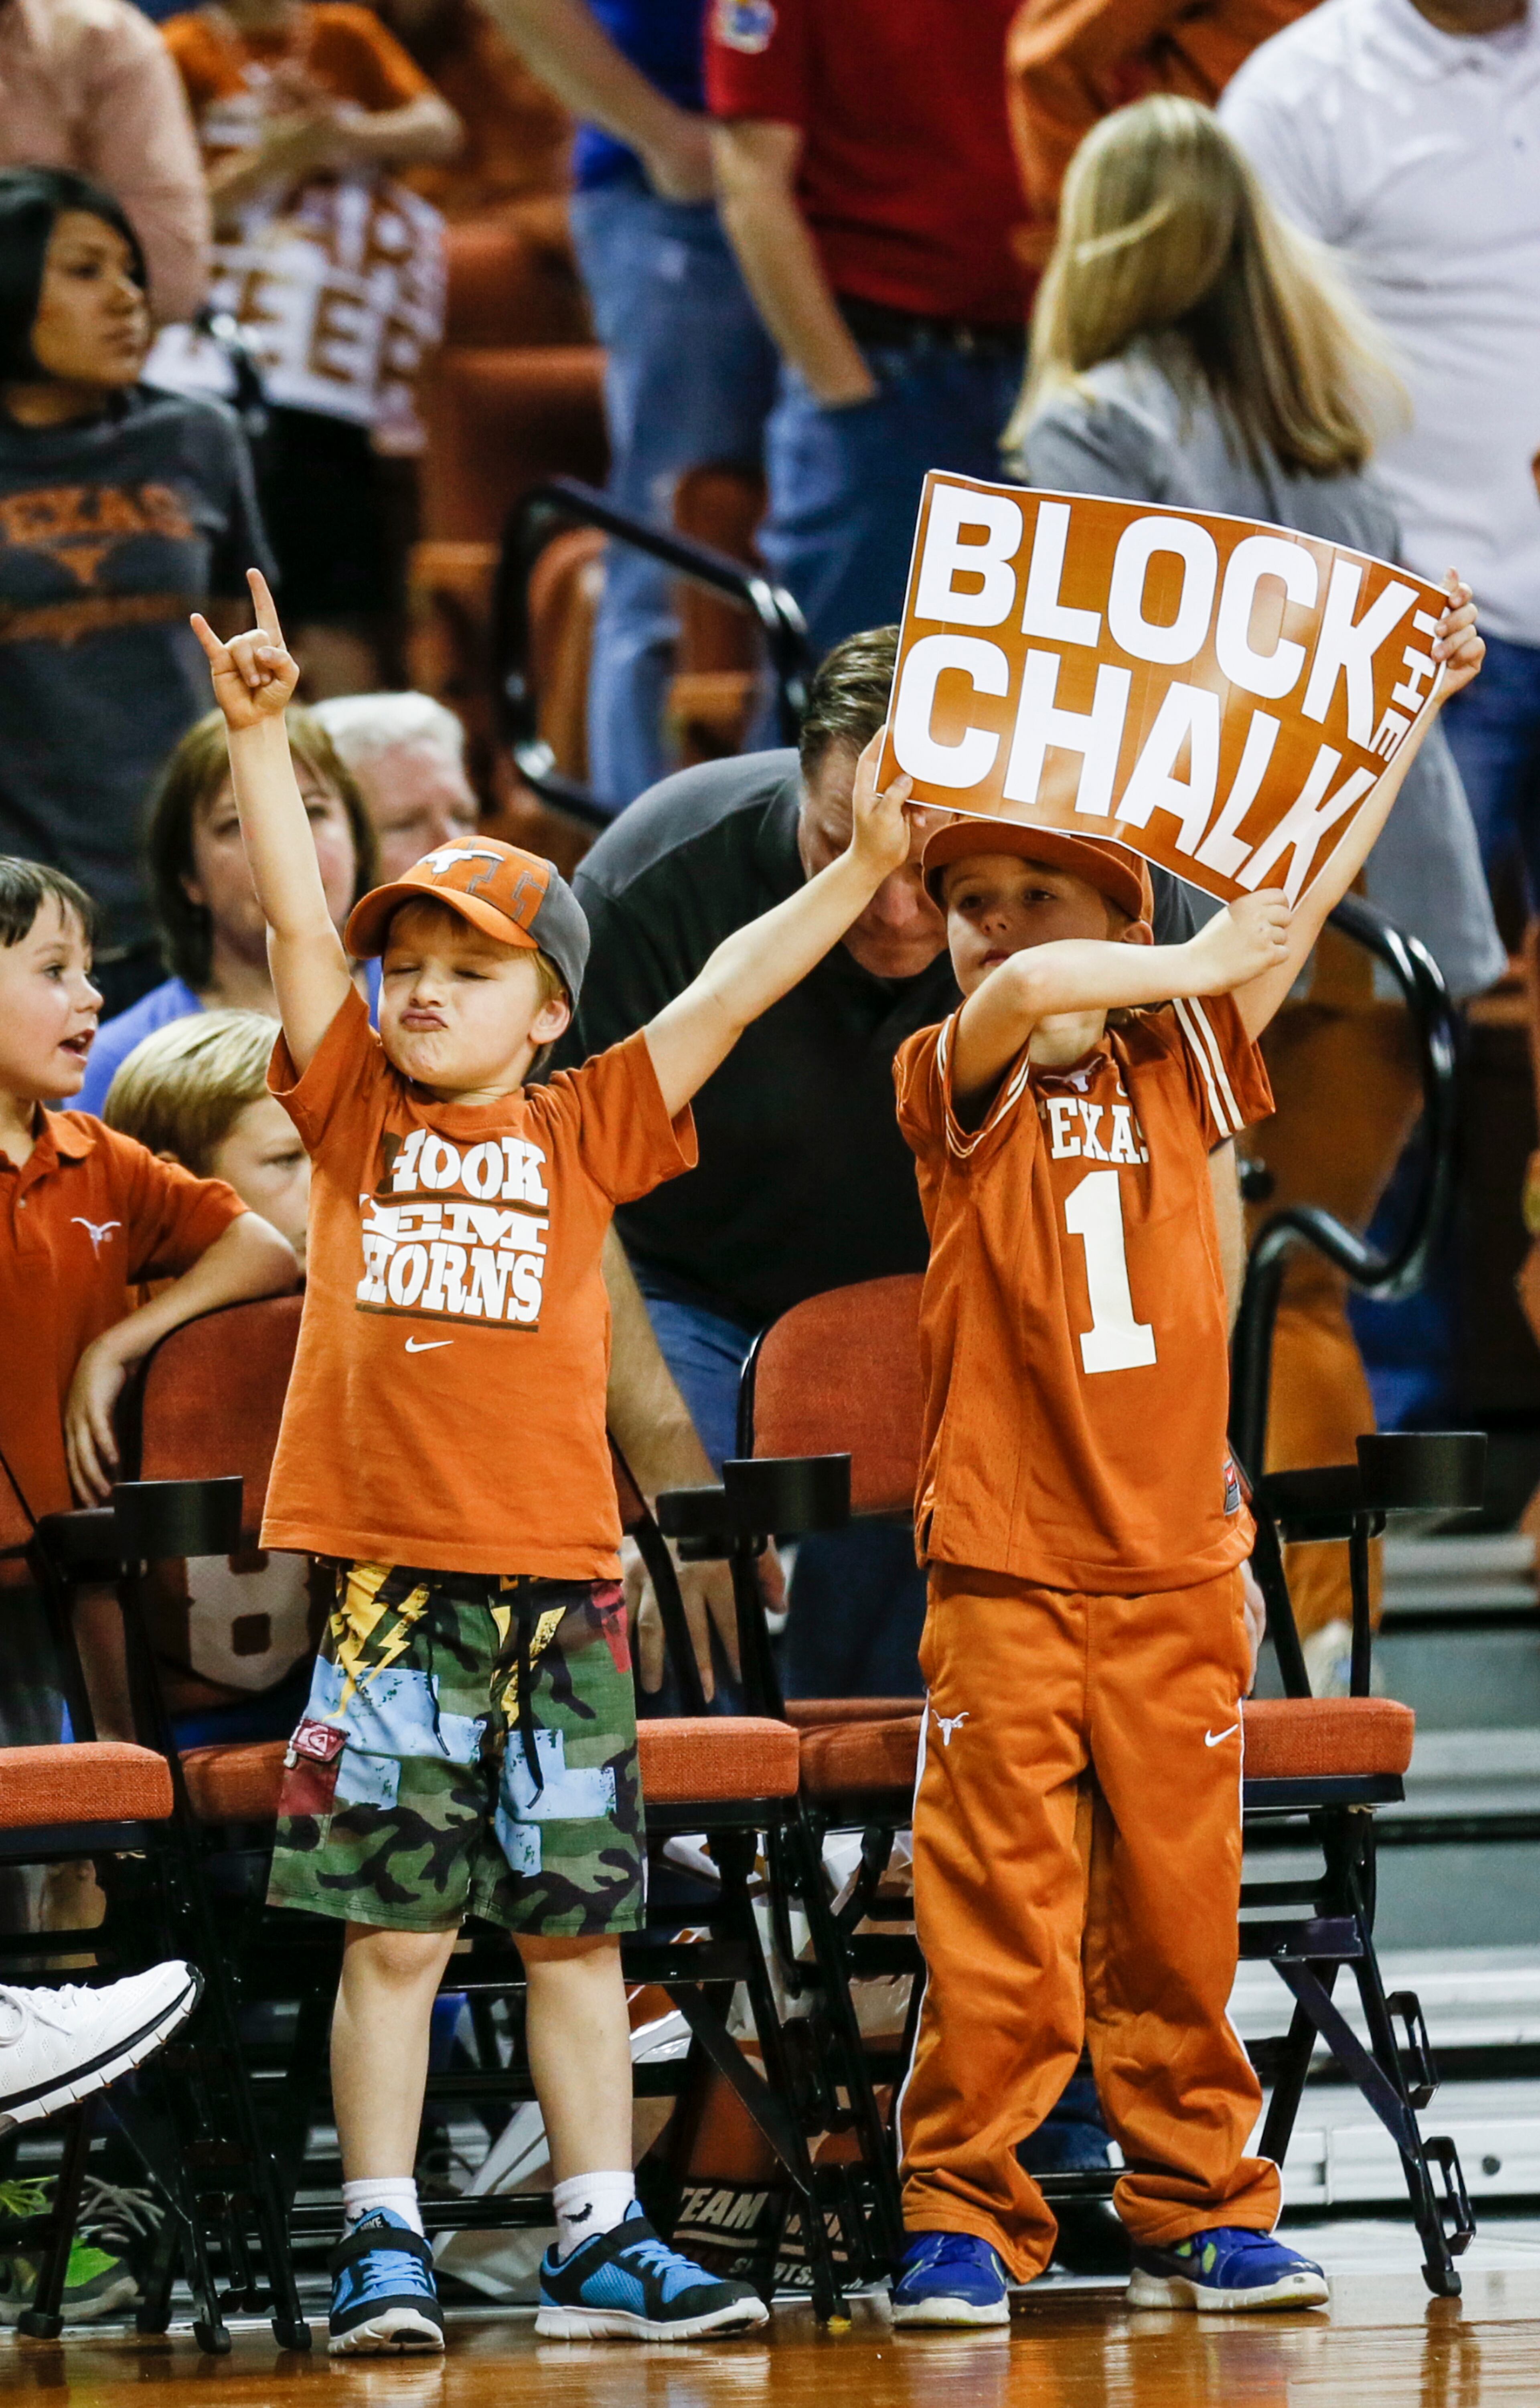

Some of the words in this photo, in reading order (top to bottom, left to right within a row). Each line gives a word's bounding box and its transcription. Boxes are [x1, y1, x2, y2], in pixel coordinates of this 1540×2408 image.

[914, 483, 1420, 751] BLOCK
[893, 633, 1378, 912] CHALK
[1038, 1097, 1149, 1164] EXA
[356, 1233, 544, 1322] HORNS
[1064, 1170, 1157, 1374] 1
